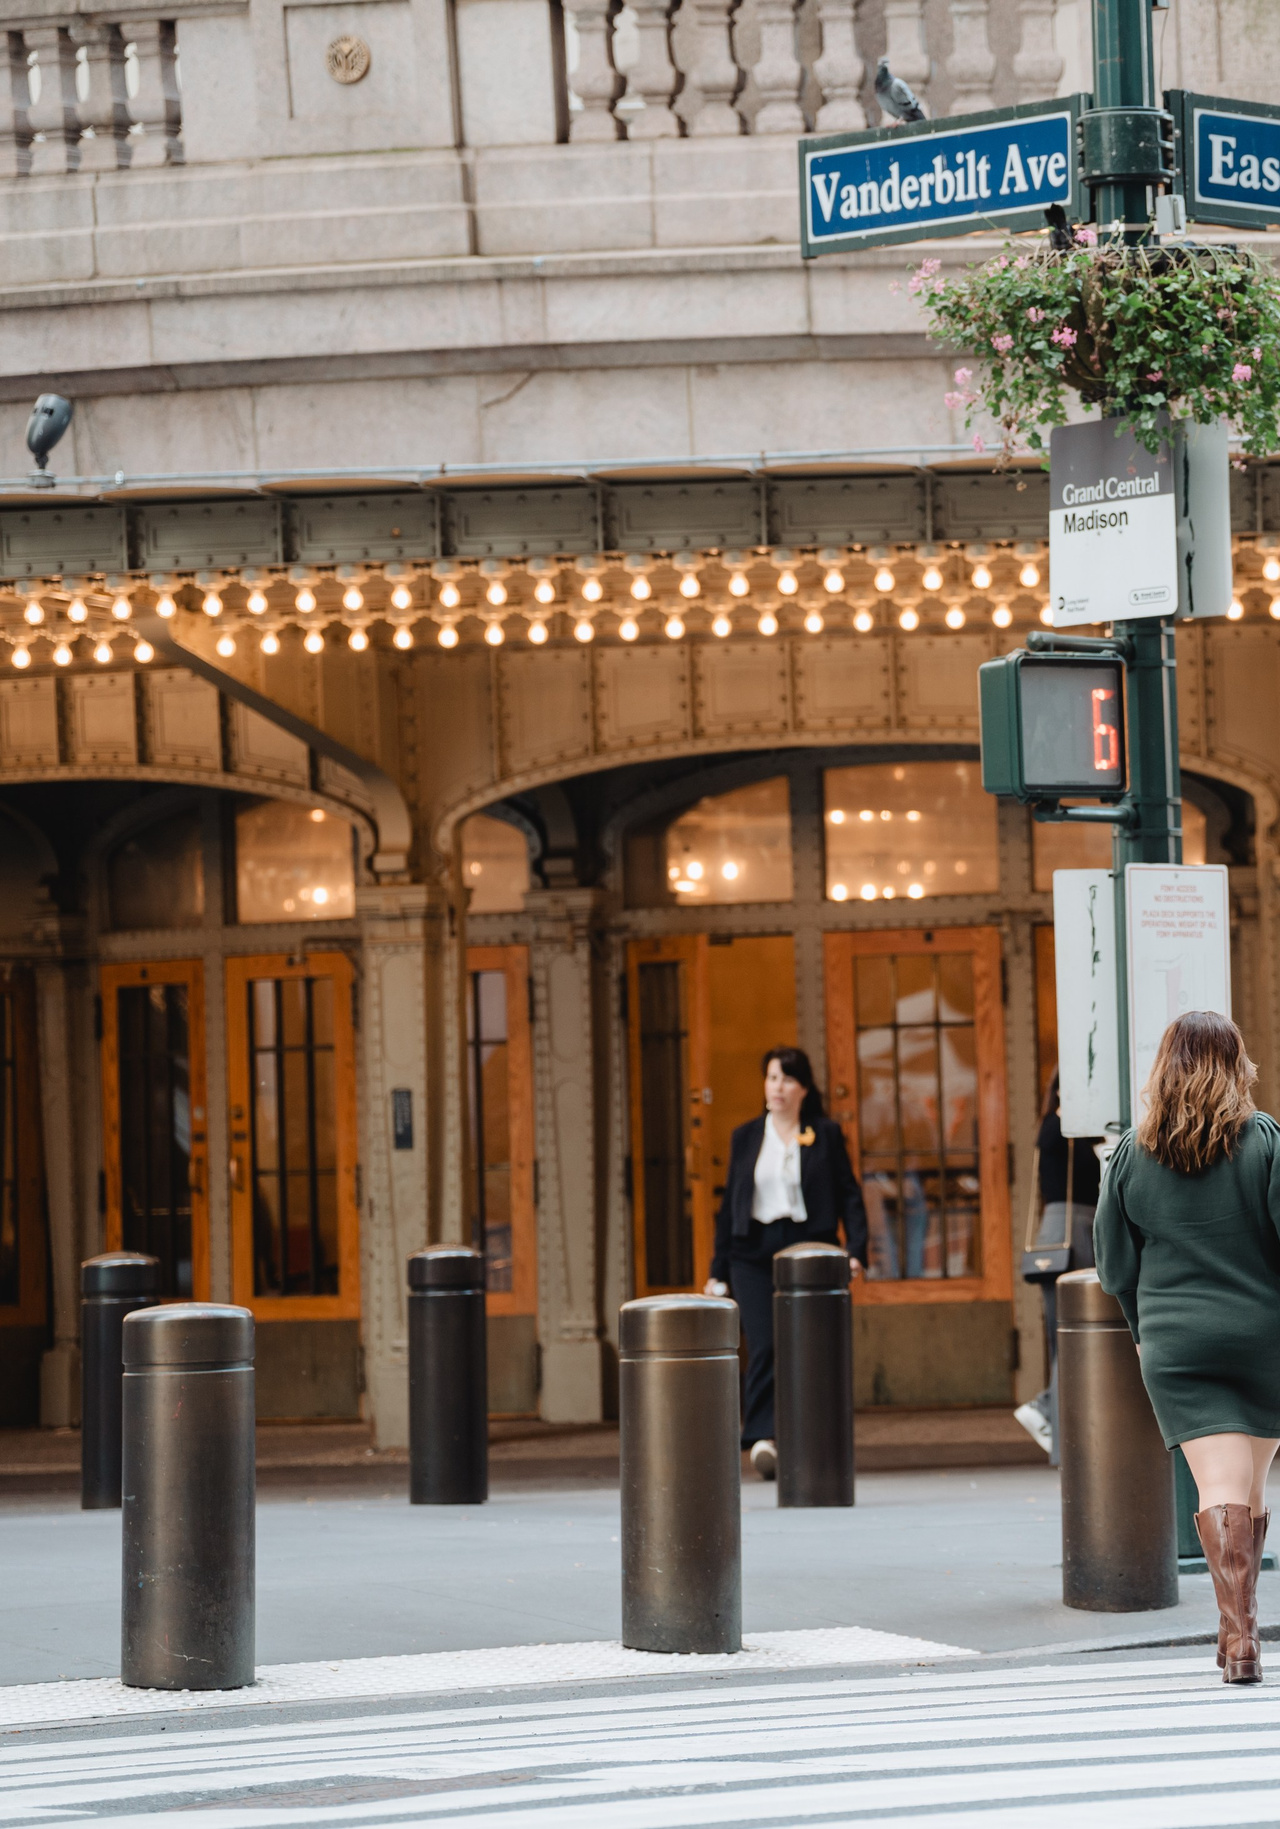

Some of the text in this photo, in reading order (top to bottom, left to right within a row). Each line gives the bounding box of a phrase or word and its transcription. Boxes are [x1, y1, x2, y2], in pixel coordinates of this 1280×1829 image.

[812, 143, 1067, 222] Vanderbilt Ave
[1062, 471, 1160, 505] Grand Central
[1064, 510, 1129, 534] Madison
[1091, 688, 1119, 770] 6
[1176, 885, 1197, 893] ACCESS
[1163, 895, 1203, 903] OBSTRUCTIONS
[1176, 910, 1205, 919] SUPPORTS
[1141, 920, 1177, 928] OPERATIONAL
[1178, 921, 1198, 929] WEIGHT
